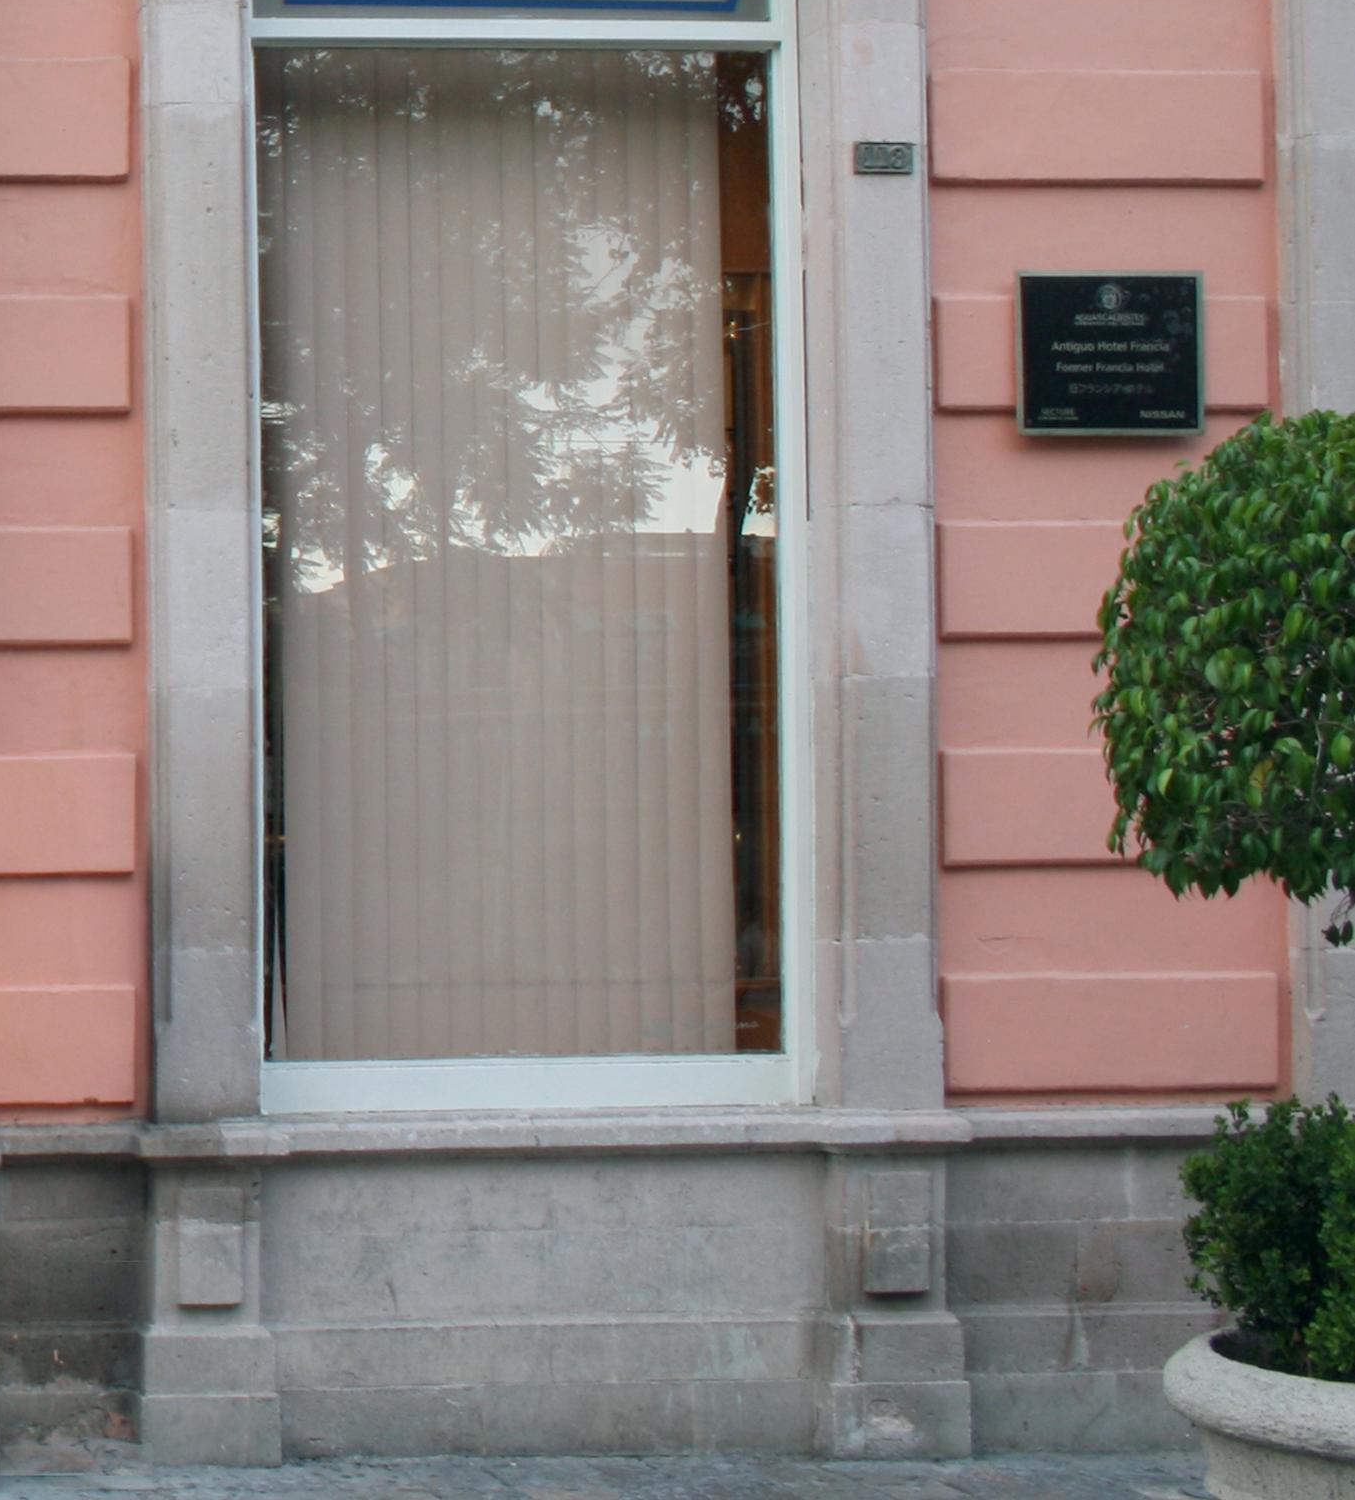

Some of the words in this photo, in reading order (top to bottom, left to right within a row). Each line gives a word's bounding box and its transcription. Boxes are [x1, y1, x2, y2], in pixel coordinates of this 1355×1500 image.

[1051, 341, 1095, 353] Antiguo
[1097, 341, 1128, 351] Hotel
[1130, 341, 1170, 352] Francia
[1056, 362, 1093, 372] Former
[1095, 362, 1134, 372] Francia
[1136, 362, 1165, 373] Hotel
[1139, 410, 1185, 419] NISSAN
